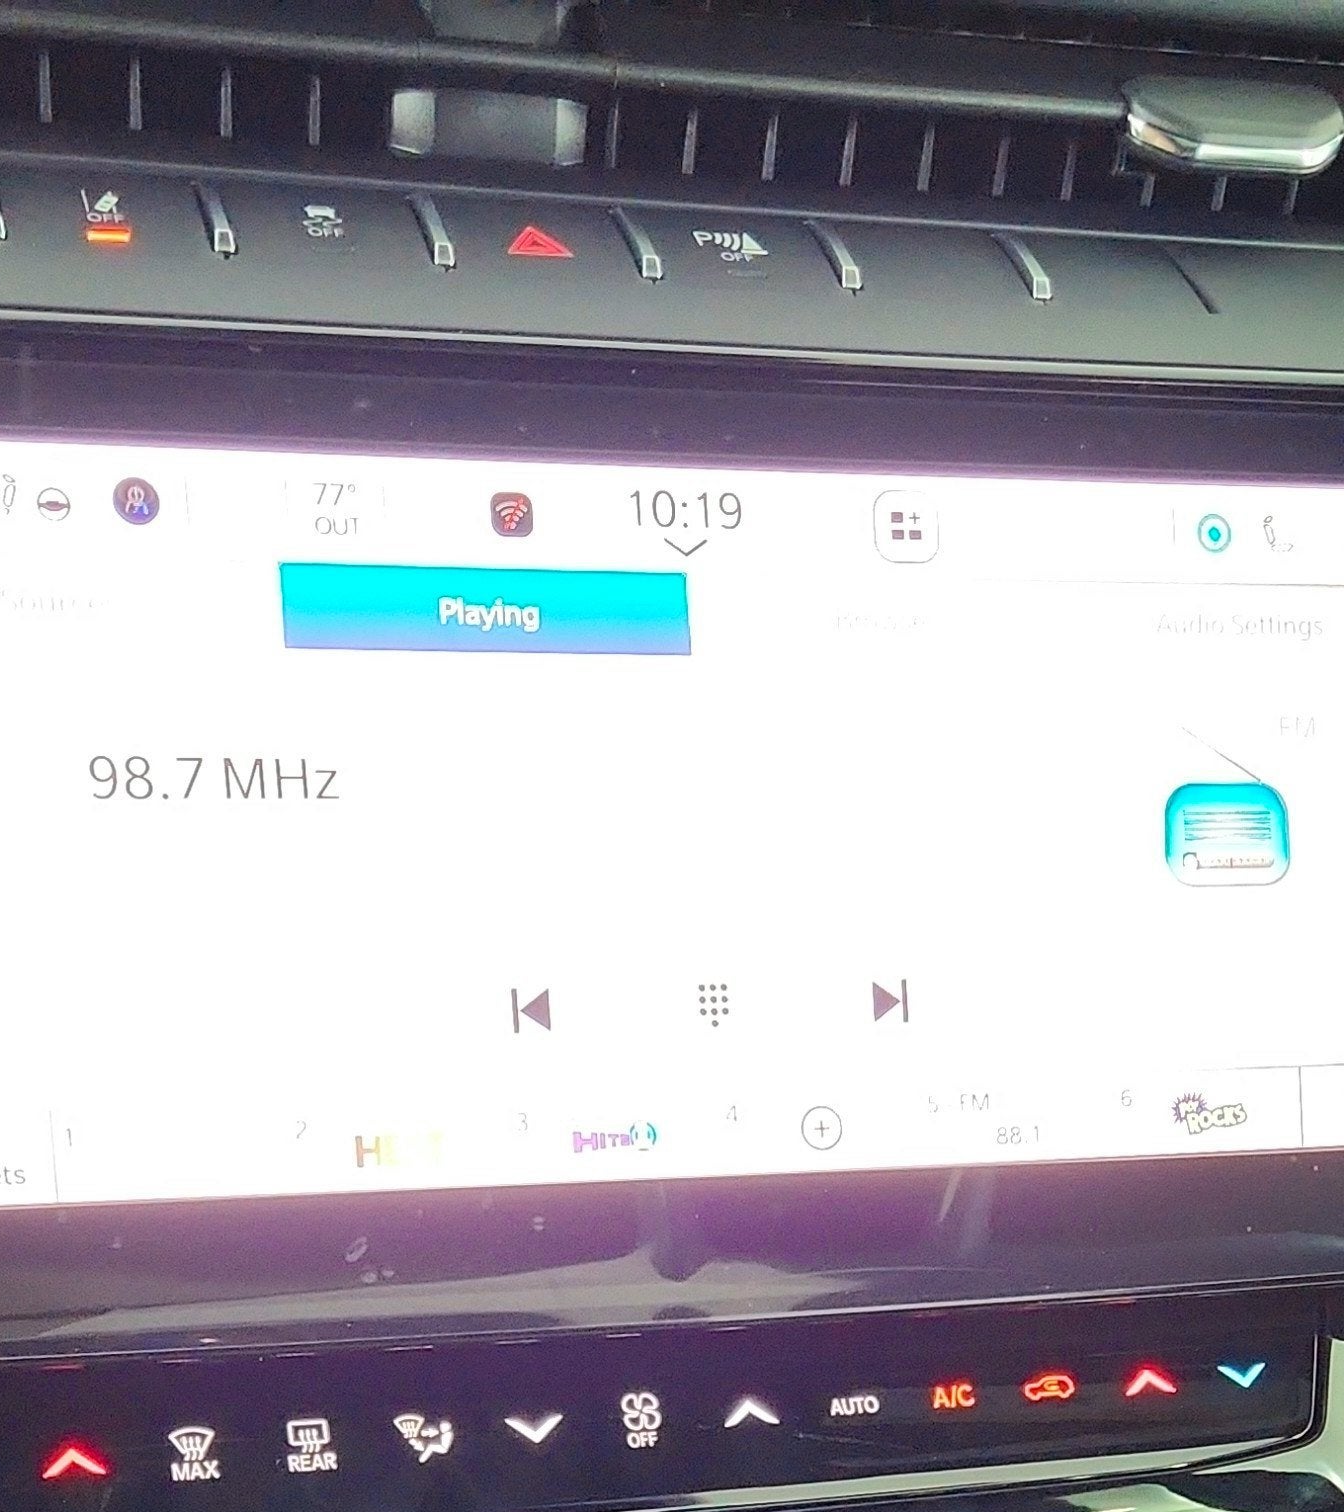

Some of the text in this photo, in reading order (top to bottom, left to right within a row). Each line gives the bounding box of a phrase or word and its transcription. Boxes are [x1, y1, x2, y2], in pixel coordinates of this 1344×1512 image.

[86, 212, 125, 223] OFF
[307, 226, 344, 238] OFF
[720, 251, 754, 262] OFF
[629, 490, 742, 529] 10:19
[315, 516, 360, 536] OUT
[438, 596, 541, 633] Playing
[89, 755, 340, 800] 98.7 MHz
[1120, 1090, 1133, 1107] 6
[517, 1112, 528, 1131] 3
[1186, 1103, 1248, 1135] ROCKS
[996, 1125, 1040, 1145] 88.1
[932, 1382, 977, 1410] A/C
[829, 1395, 881, 1418] AUTO
[626, 1431, 659, 1449] OFF
[170, 1460, 221, 1482] MAX
[286, 1452, 338, 1473] REAR
